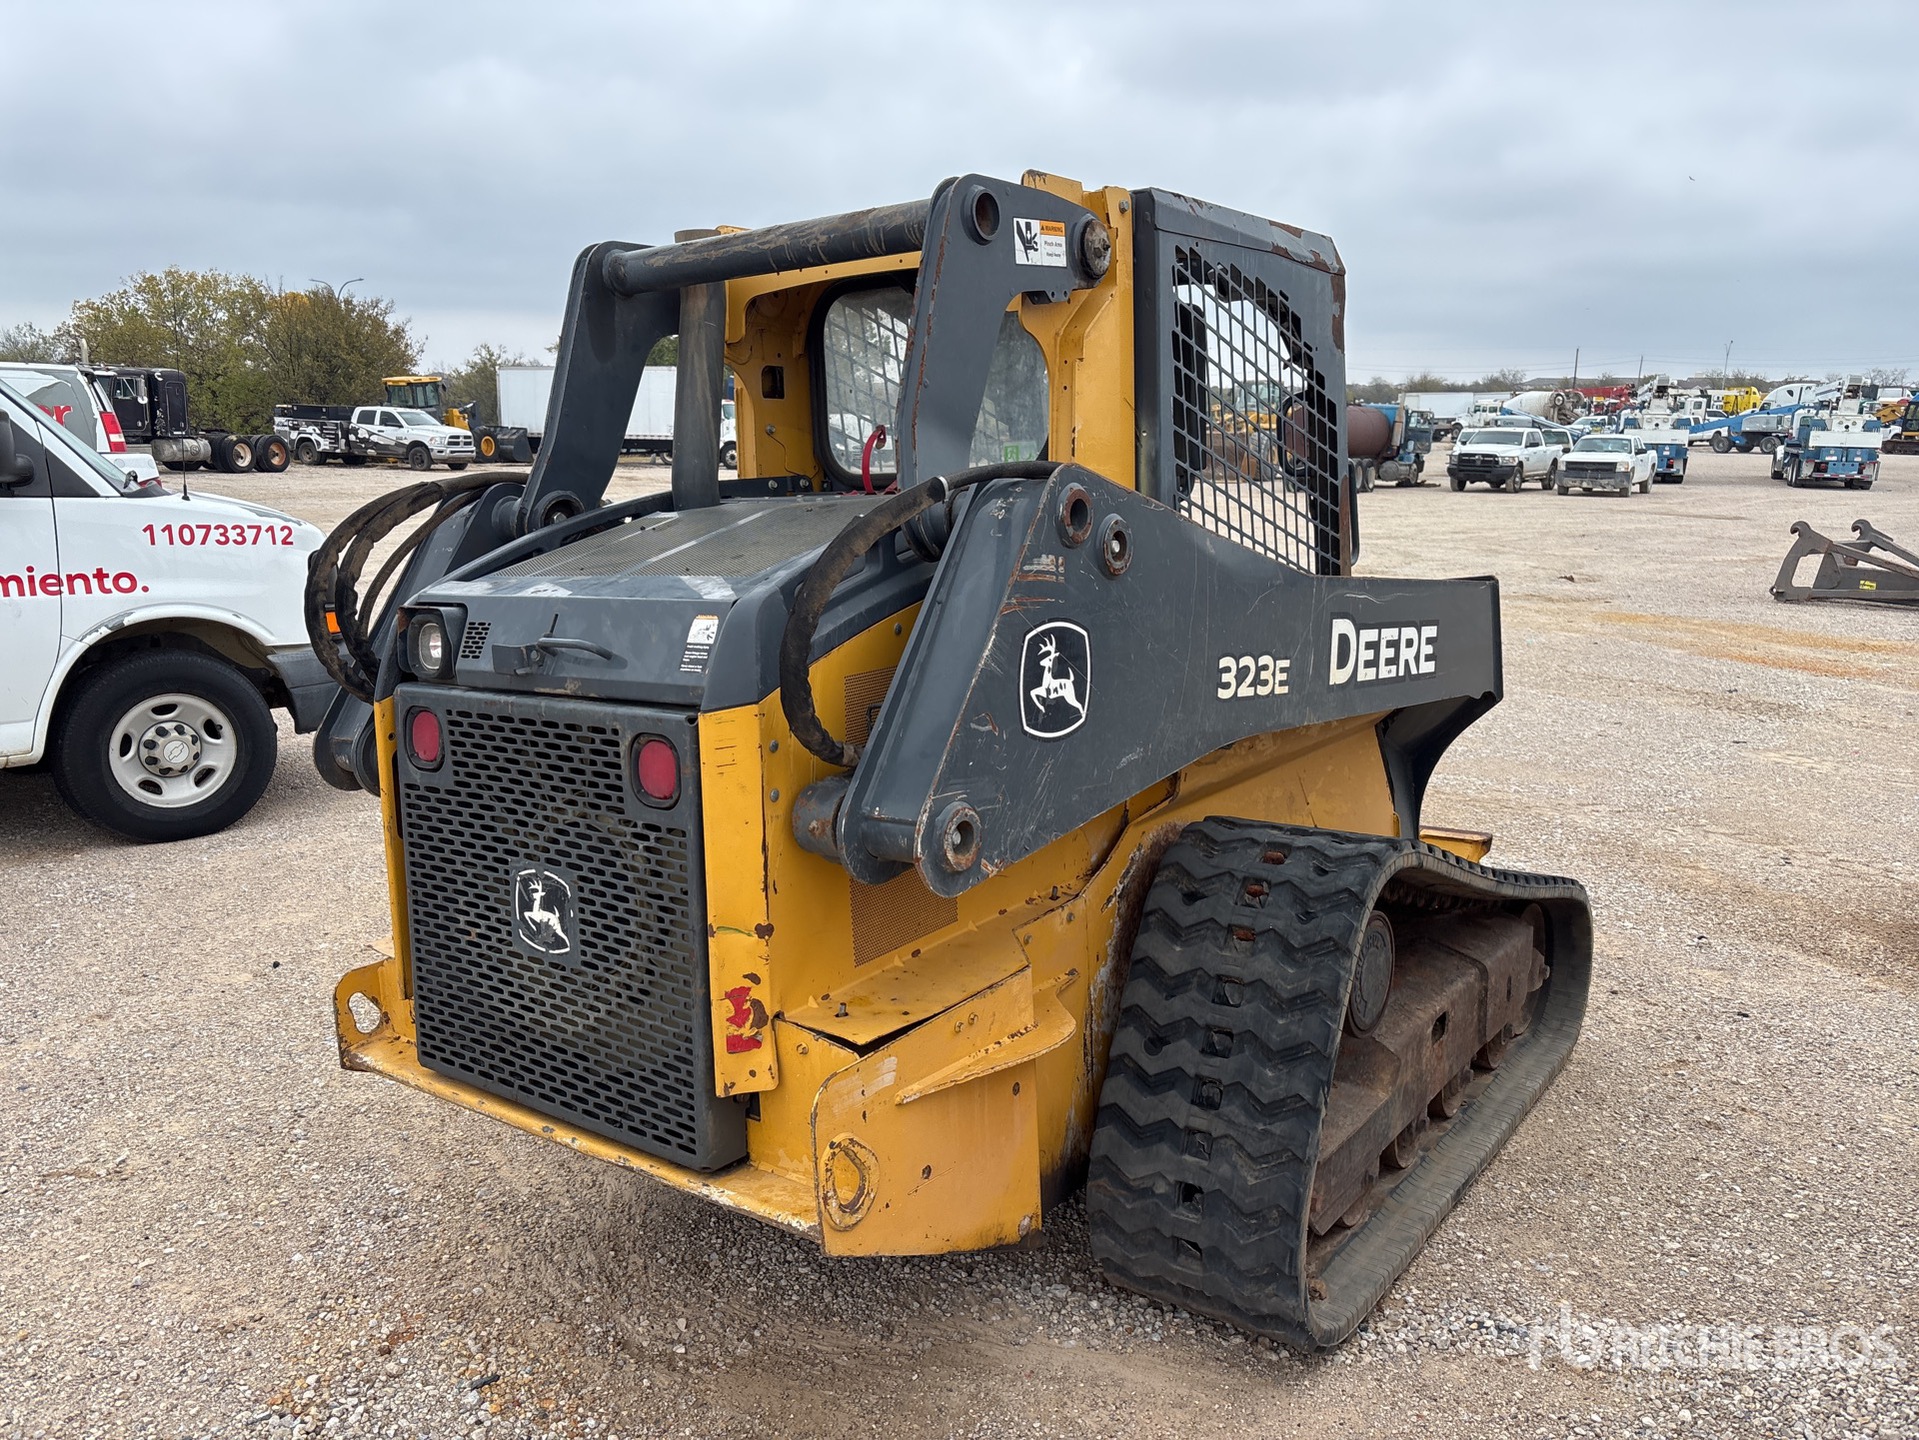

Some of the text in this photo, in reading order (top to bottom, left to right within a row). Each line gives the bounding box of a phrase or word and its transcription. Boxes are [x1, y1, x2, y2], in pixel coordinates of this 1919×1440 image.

[142, 524, 294, 546] 110733712
[1329, 618, 1438, 686] DEERE
[1217, 654, 1291, 699] 323E
